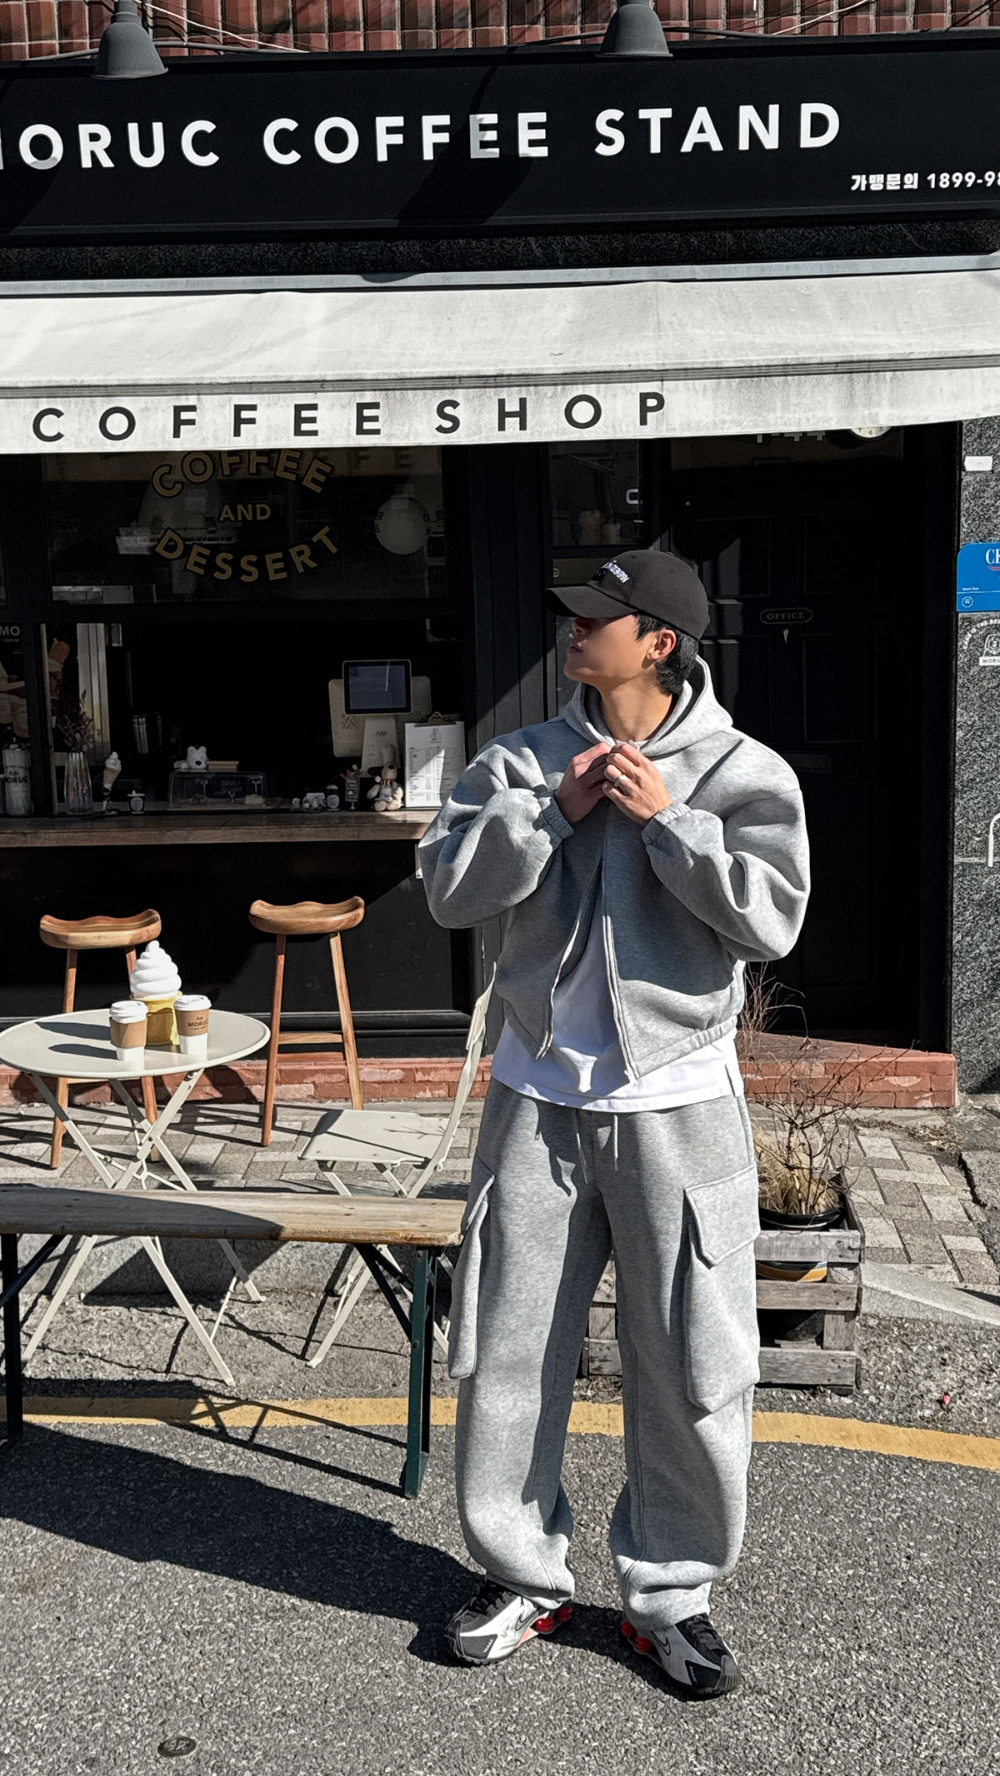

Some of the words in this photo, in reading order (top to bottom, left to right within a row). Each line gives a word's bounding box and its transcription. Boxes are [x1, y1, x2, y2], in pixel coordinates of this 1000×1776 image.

[0, 119, 220, 170] ORUC
[263, 112, 549, 165] COFFEE
[594, 102, 840, 156] STAND
[851, 172, 919, 191] 가맹문의
[927, 171, 1000, 189] 1899-9
[32, 401, 381, 442] COFFEE
[435, 391, 665, 434] SHOP
[152, 450, 332, 498] COFFEE
[218, 503, 272, 522] AND
[155, 526, 339, 583] DESSERT
[767, 612, 805, 620] OFFICE
